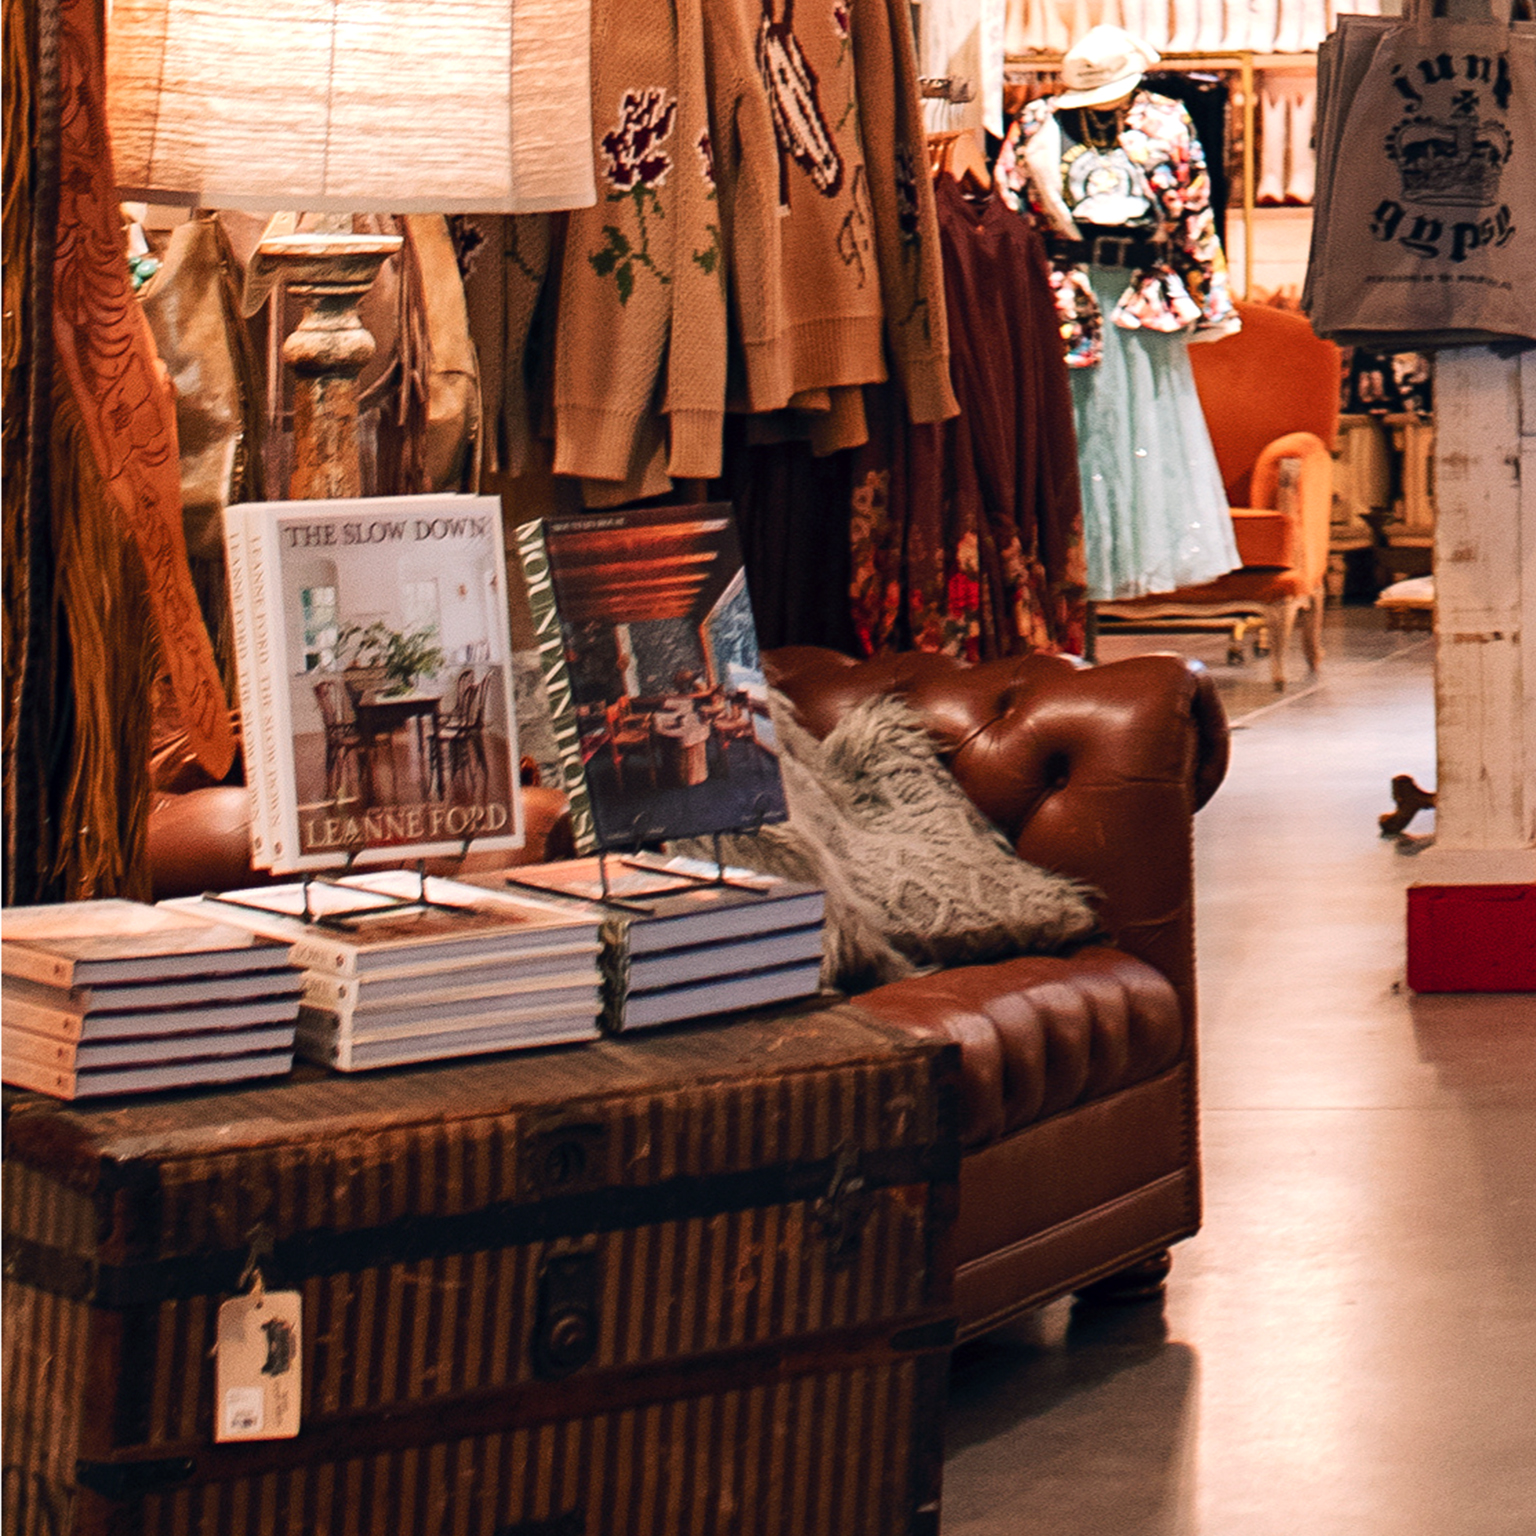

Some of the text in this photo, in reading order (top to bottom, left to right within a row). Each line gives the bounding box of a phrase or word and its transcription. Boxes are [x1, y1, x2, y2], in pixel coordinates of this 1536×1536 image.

[1369, 199, 1516, 263] gypsy
[284, 516, 489, 549] THE SLOW DOWN
[305, 802, 508, 848] LEANNE FORD
